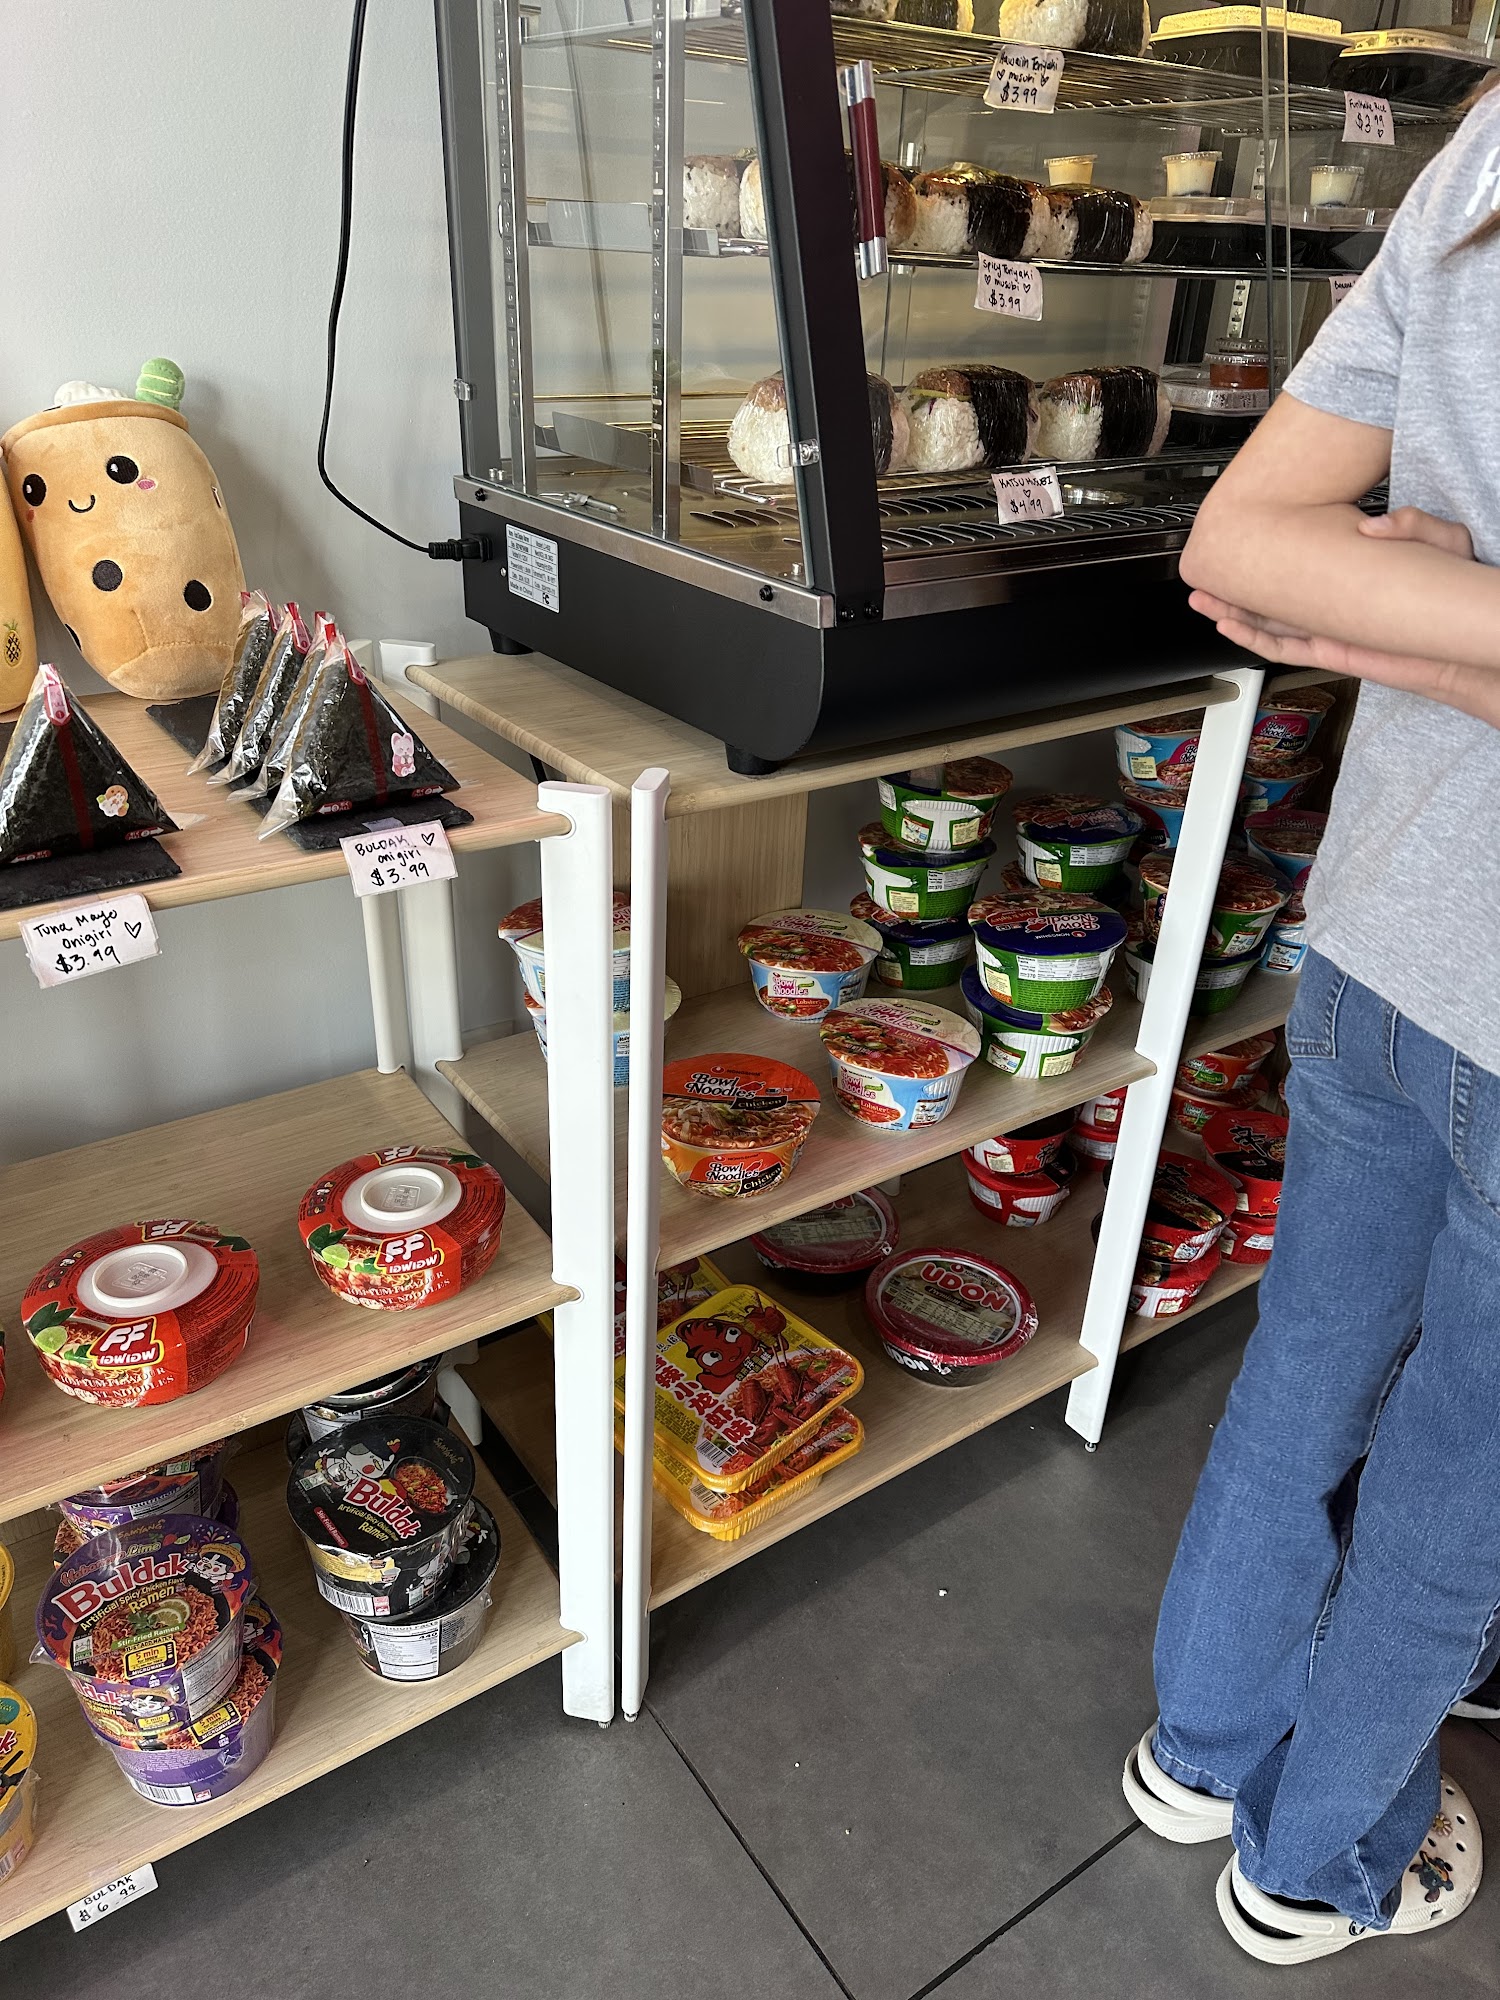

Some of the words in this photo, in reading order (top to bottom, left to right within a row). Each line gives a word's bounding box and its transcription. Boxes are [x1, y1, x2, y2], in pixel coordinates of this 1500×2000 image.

[1001, 81, 1038, 105] $3.99
[983, 259, 1002, 278] Spicy
[1002, 264, 1034, 282] Teriyaki
[988, 289, 1021, 312] $3.99
[998, 477, 1025, 489] KATSU
[355, 834, 412, 857] BULDAK
[370, 862, 430, 887] $3.99
[33, 922, 73, 938] Tuna
[75, 909, 118, 929] Mayo
[1026, 913, 1099, 926] Noodles
[1053, 921, 1100, 932] Bowl
[55, 945, 121, 974] $3.99
[772, 976, 797, 988] Bowl
[773, 985, 809, 996] Noodles
[856, 1007, 922, 1031] Noodles
[894, 1029, 931, 1045] Lobster
[692, 1073, 740, 1088] Bowl
[842, 1070, 864, 1086] Bowl
[684, 1083, 757, 1099] Noodles
[841, 1081, 877, 1100] Noodles
[737, 1098, 782, 1109] Chicken
[860, 1100, 888, 1114] Lobster
[705, 1169, 760, 1182] Noodles
[709, 1162, 744, 1173] Bowl
[744, 1166, 781, 1190] Chicken
[384, 1233, 426, 1262] FF
[397, 1278, 451, 1303] NOODLES
[920, 1262, 1010, 1312] UDON
[99, 1323, 149, 1352] FF
[112, 1374, 175, 1398] NOODLES
[337, 1503, 366, 1519] Artificial
[364, 1511, 378, 1525] Spicy
[342, 1475, 422, 1540] Buldak
[118, 1519, 166, 1538] SAMYANG
[358, 1522, 390, 1542] Ramen
[126, 1541, 162, 1557] Lime
[50, 1552, 190, 1624] Buldak
[80, 1601, 120, 1632] Artificial
[119, 1587, 142, 1606] Spicy
[141, 1581, 167, 1596] Chicken
[166, 1576, 187, 1587] Flavor
[128, 1585, 175, 1614] Ramen
[117, 1631, 153, 1648] Stir-Fried
[153, 1624, 180, 1636] Ramen
[135, 1653, 142, 1661] 5
[143, 1648, 160, 1658] min
[131, 1663, 166, 1676] MICROWAVE
[206, 1710, 221, 1722] min
[83, 1874, 133, 1906] BULDAK
